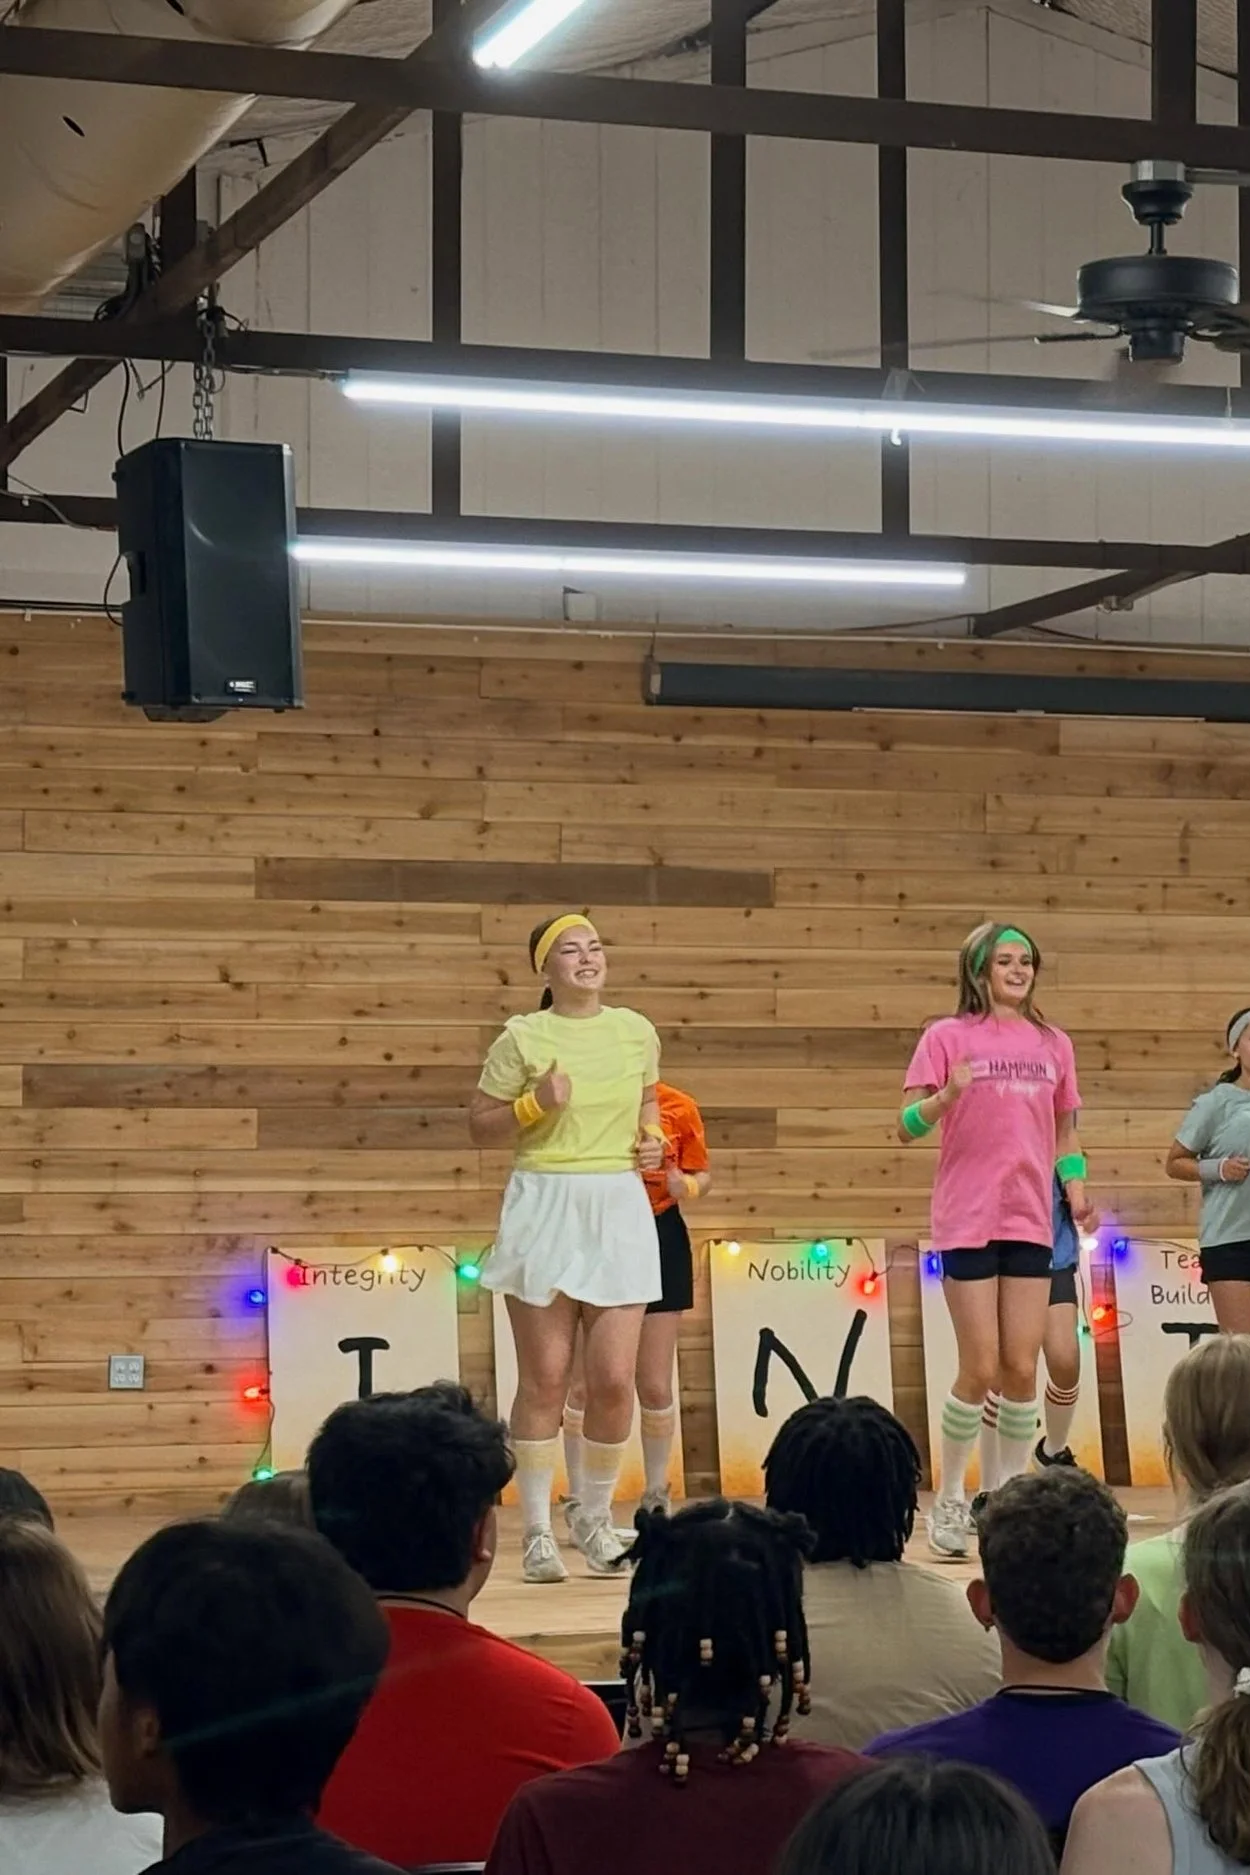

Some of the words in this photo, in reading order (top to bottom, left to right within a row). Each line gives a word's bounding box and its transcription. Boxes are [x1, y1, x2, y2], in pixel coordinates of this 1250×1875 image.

[299, 1262, 426, 1292] Integrity
[749, 1259, 851, 1288] Nobility
[753, 1309, 867, 1417] N
